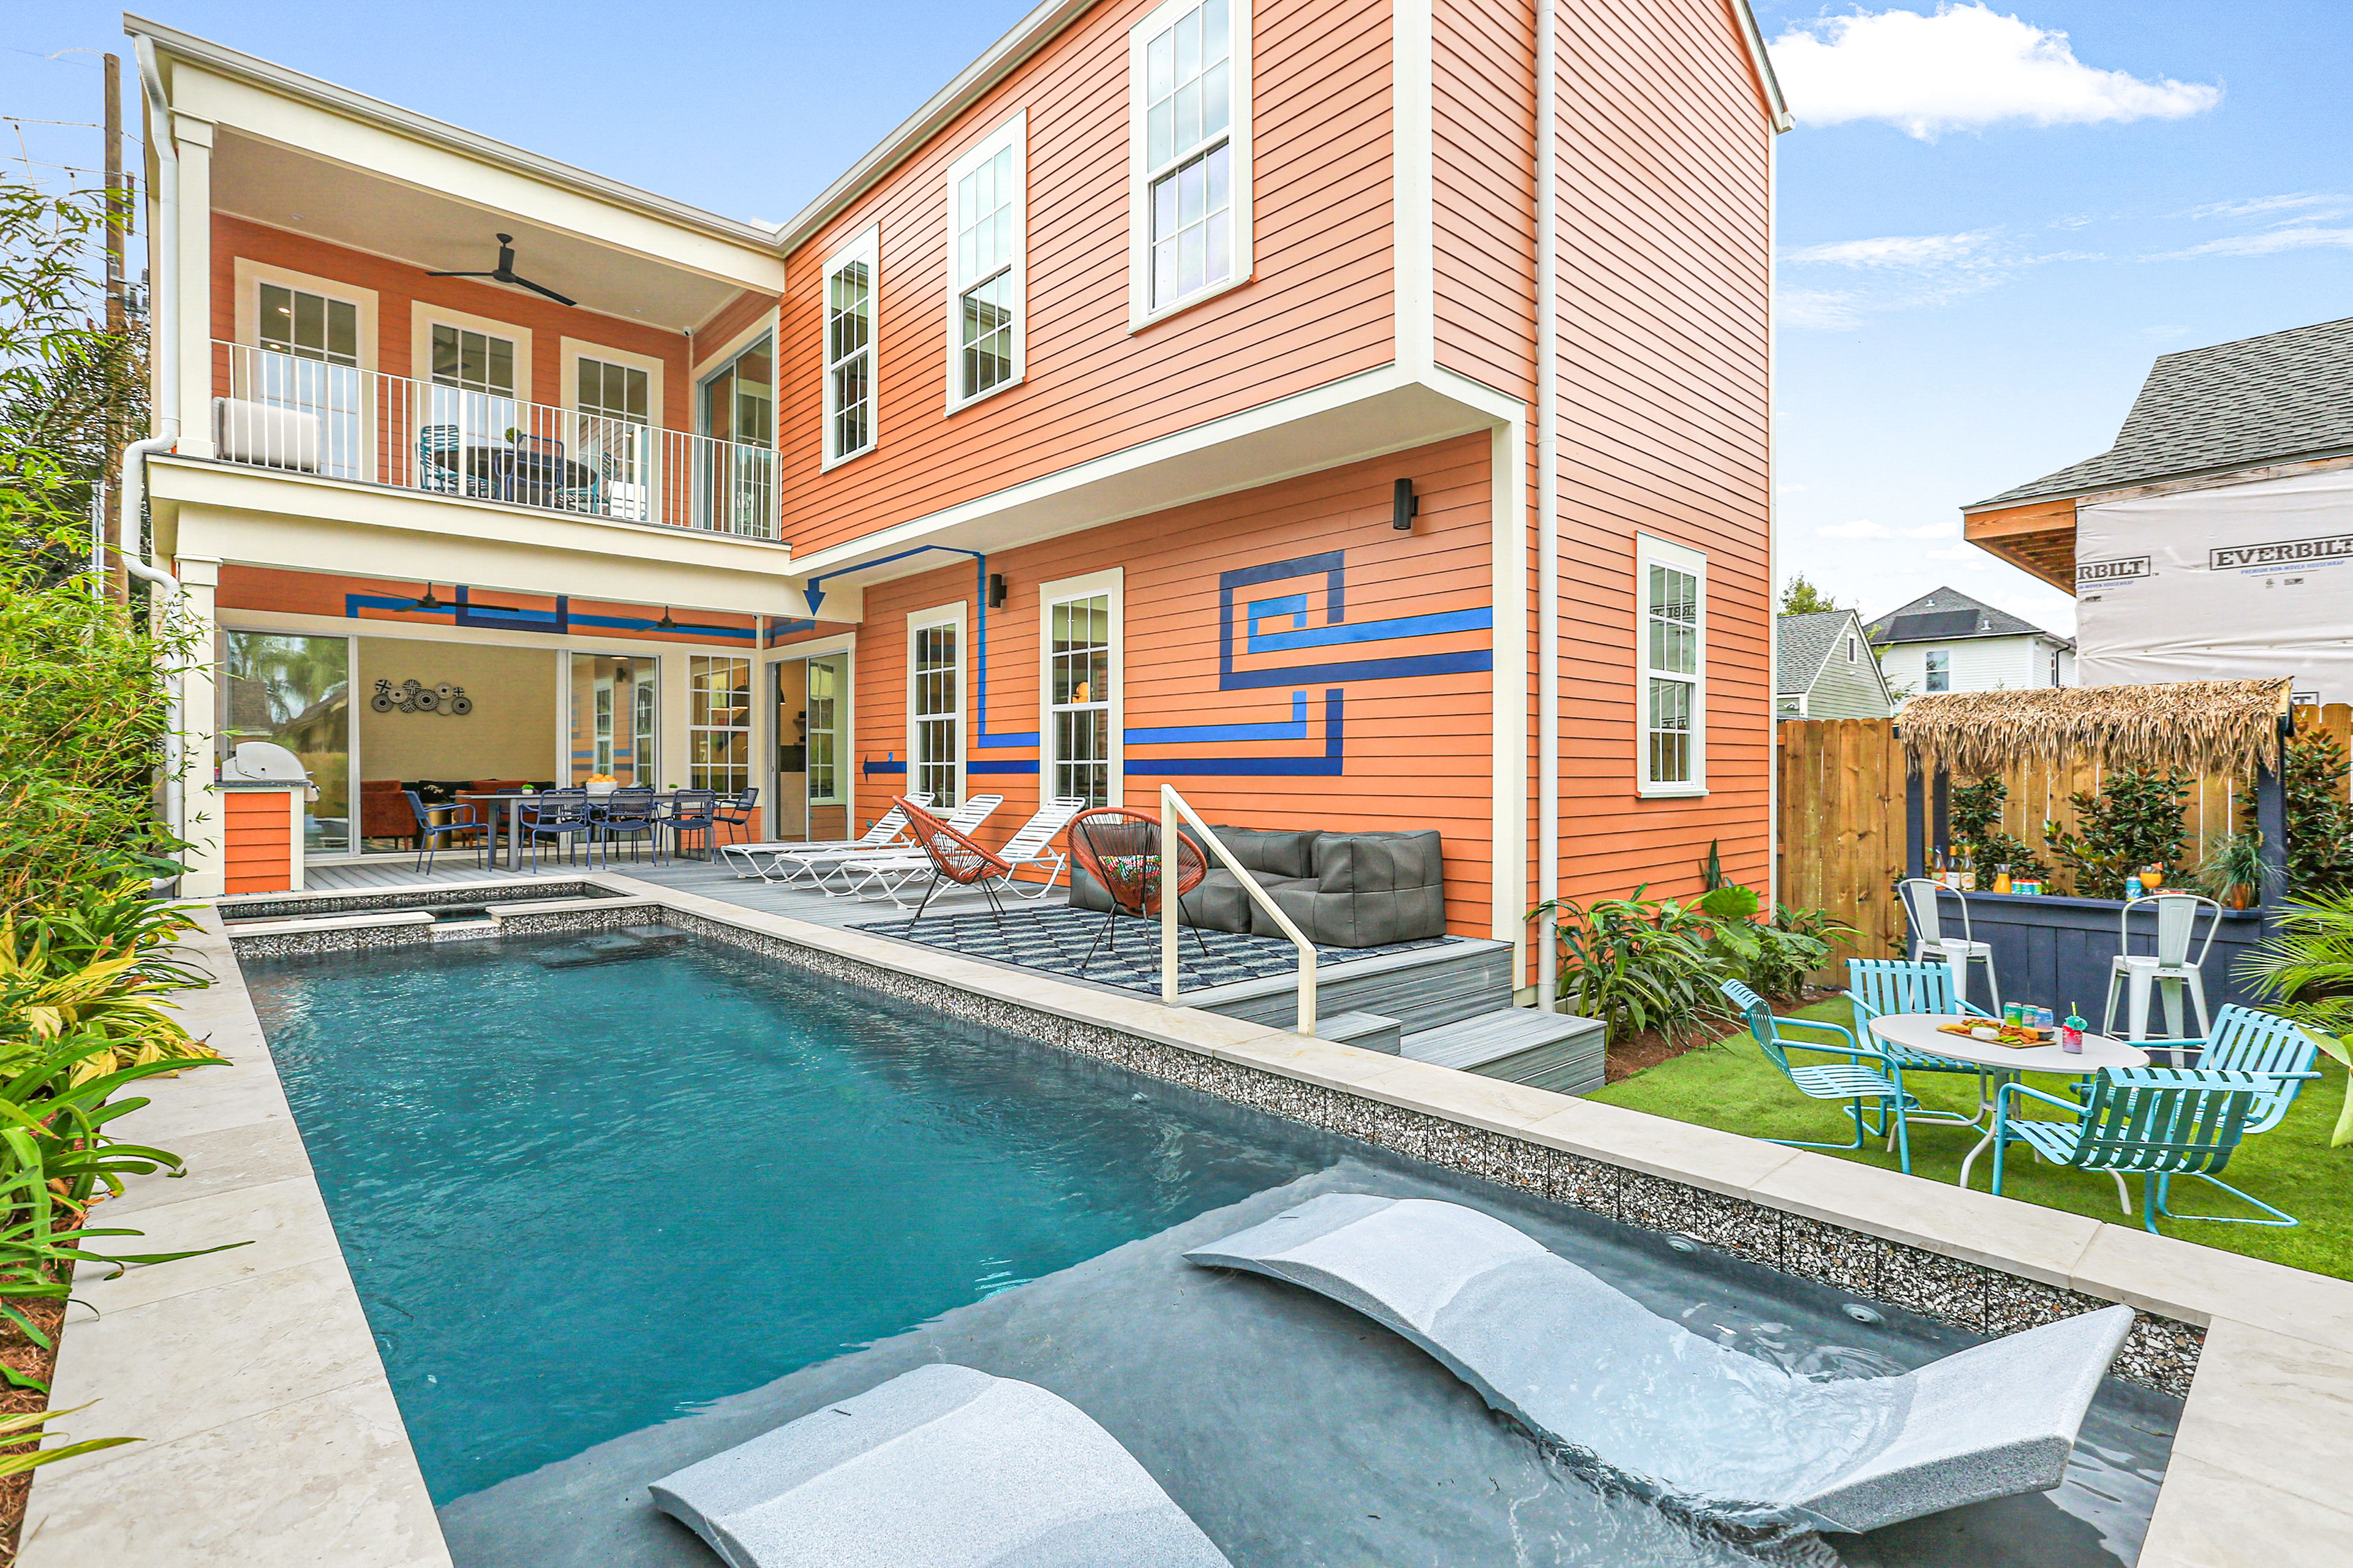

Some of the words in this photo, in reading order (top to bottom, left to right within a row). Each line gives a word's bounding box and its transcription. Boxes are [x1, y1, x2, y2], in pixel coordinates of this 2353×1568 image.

[2216, 538, 2353, 566] EVERBILT
[2078, 560, 2144, 580] RBILT
[2270, 564, 2305, 572] NON-WOVEN
